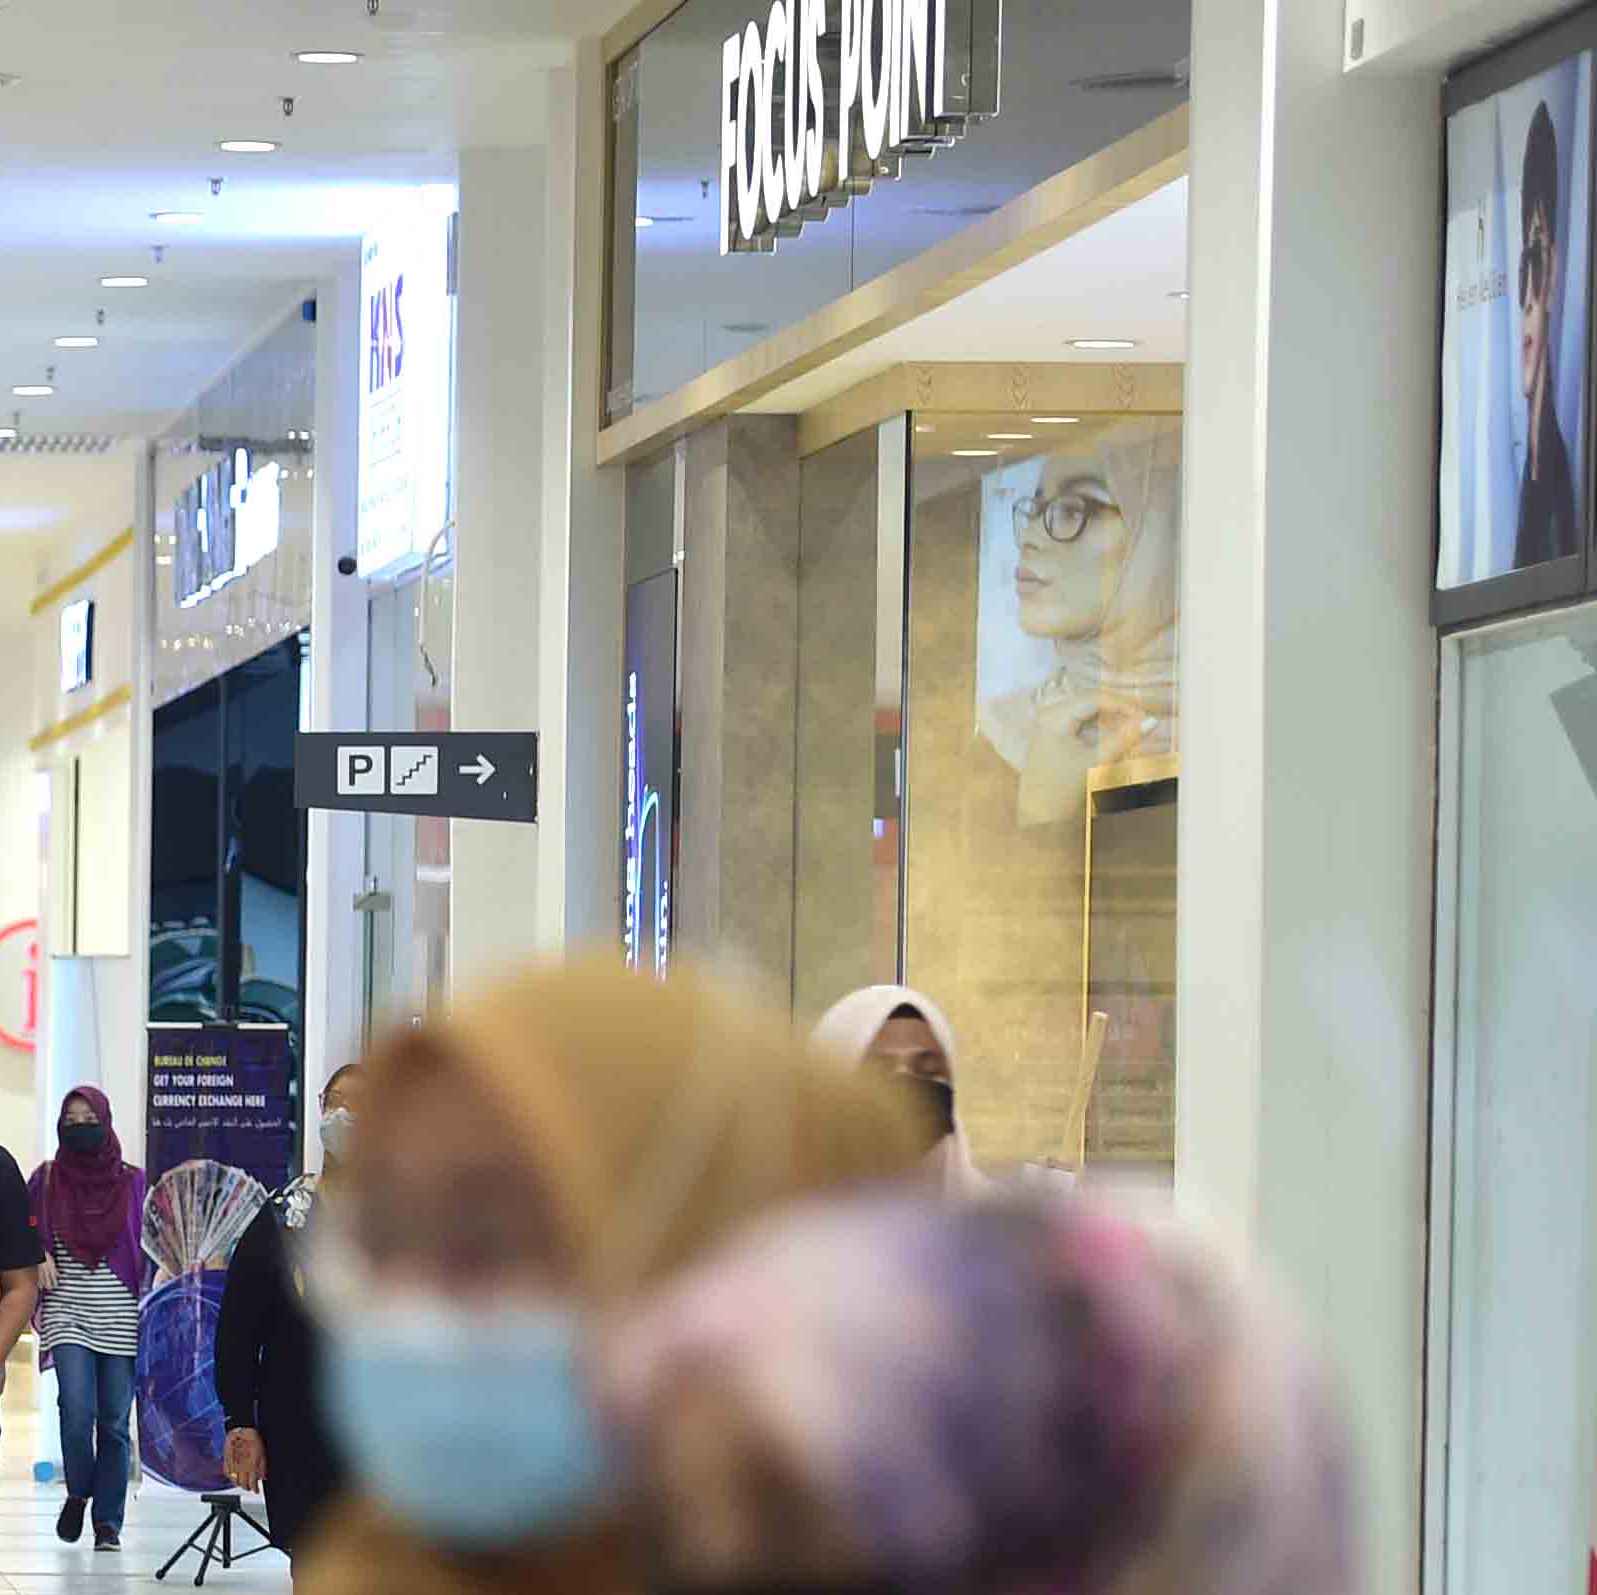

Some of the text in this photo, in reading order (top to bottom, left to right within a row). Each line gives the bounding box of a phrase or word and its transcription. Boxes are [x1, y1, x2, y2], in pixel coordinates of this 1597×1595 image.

[720, 0, 824, 256] FOCUS
[348, 754, 374, 786] P
[153, 1074, 234, 1087] GET YOUR FOREIGN
[153, 1095, 266, 1108] CURRENCY EXCHANGE HERE
